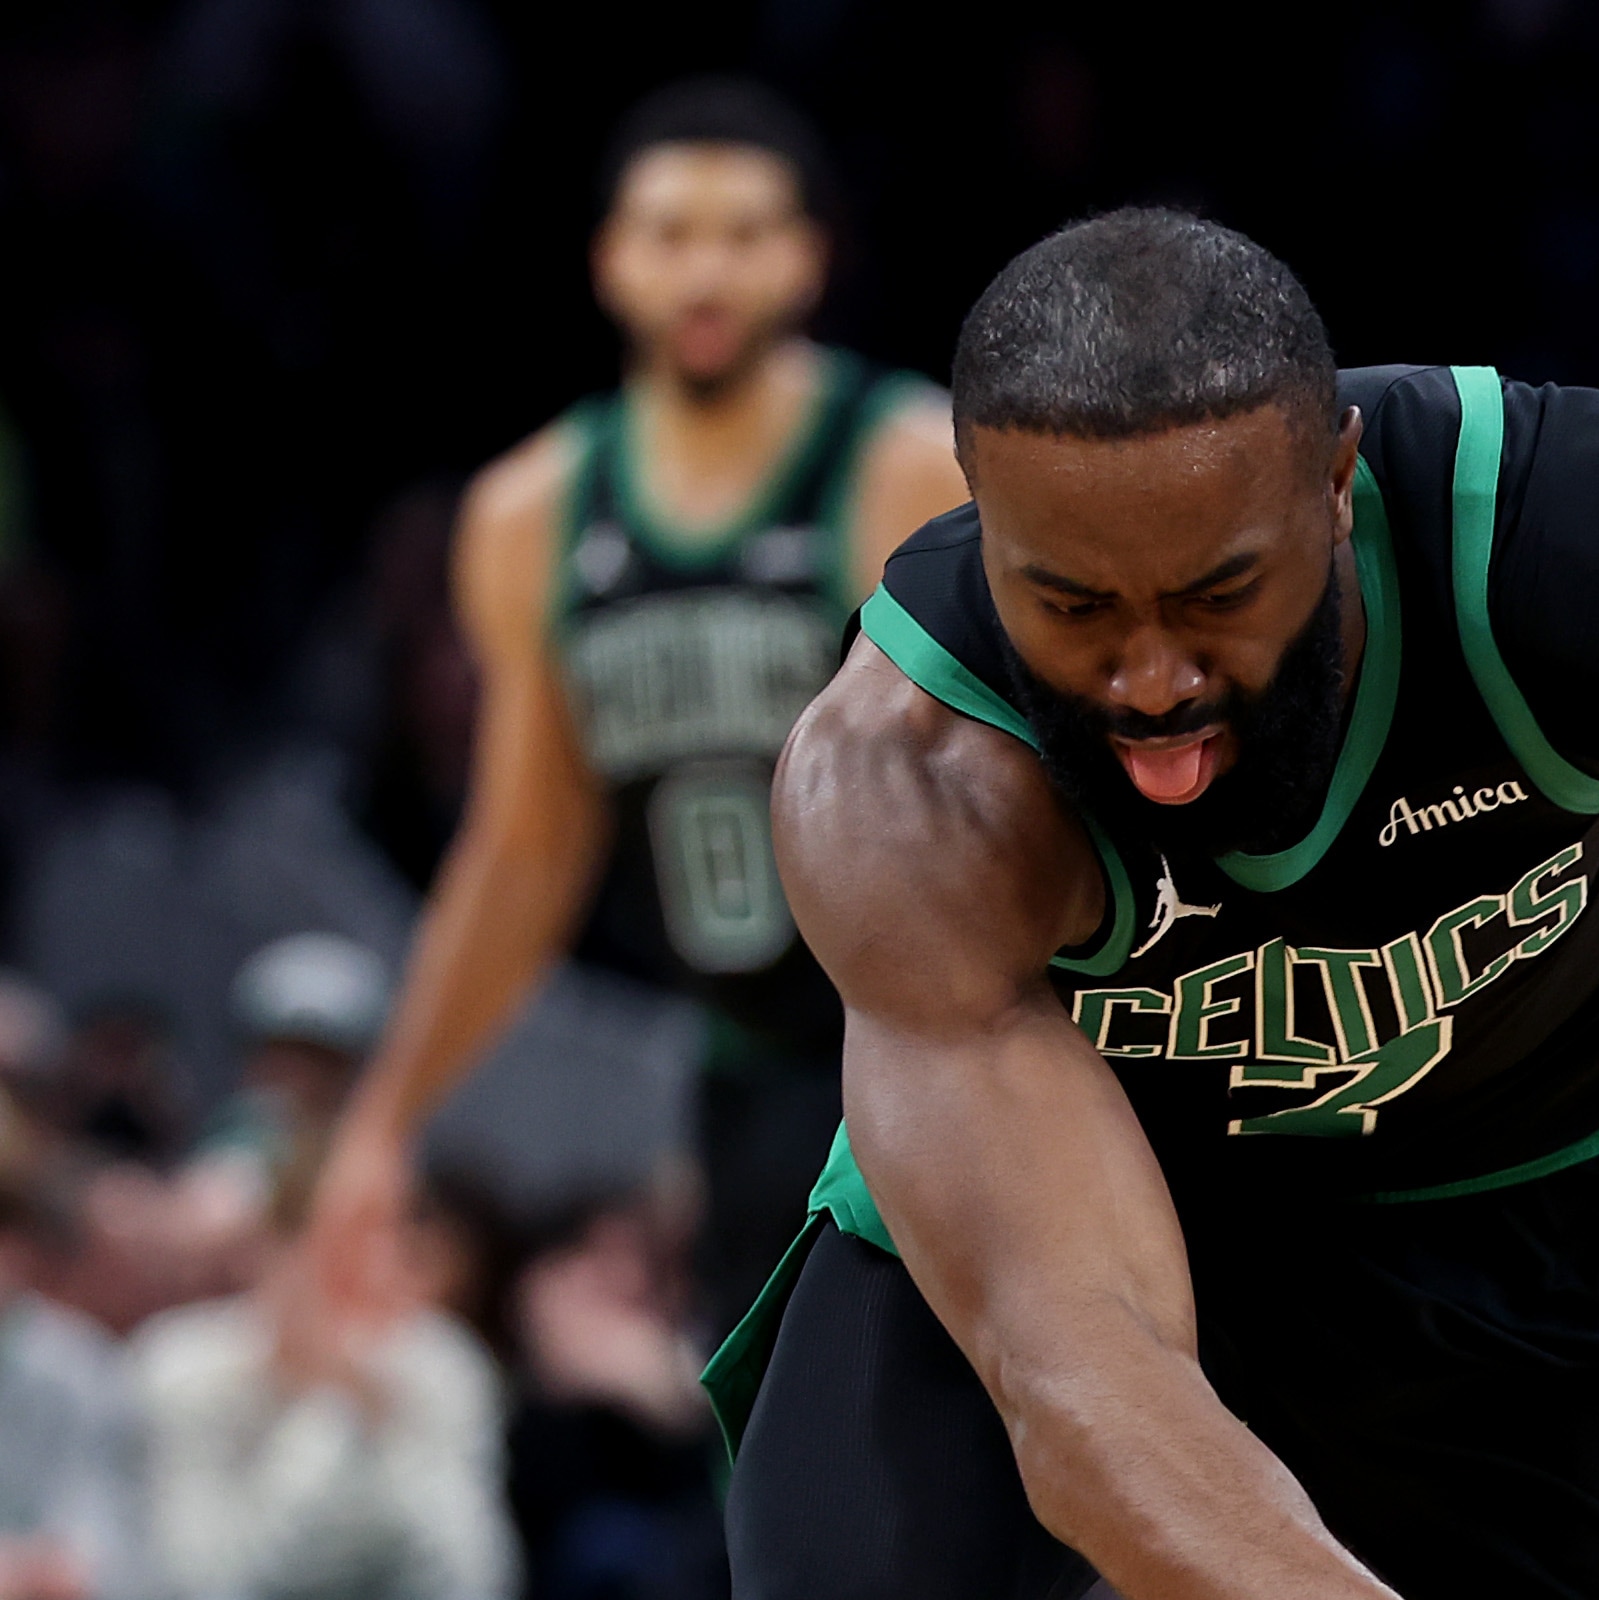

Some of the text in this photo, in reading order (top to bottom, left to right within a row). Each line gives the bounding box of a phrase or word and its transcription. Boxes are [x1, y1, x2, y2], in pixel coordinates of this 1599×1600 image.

[1379, 779, 1529, 848] Amica
[1072, 841, 1589, 1065] CELTICS
[1227, 1014, 1454, 1137] 7
